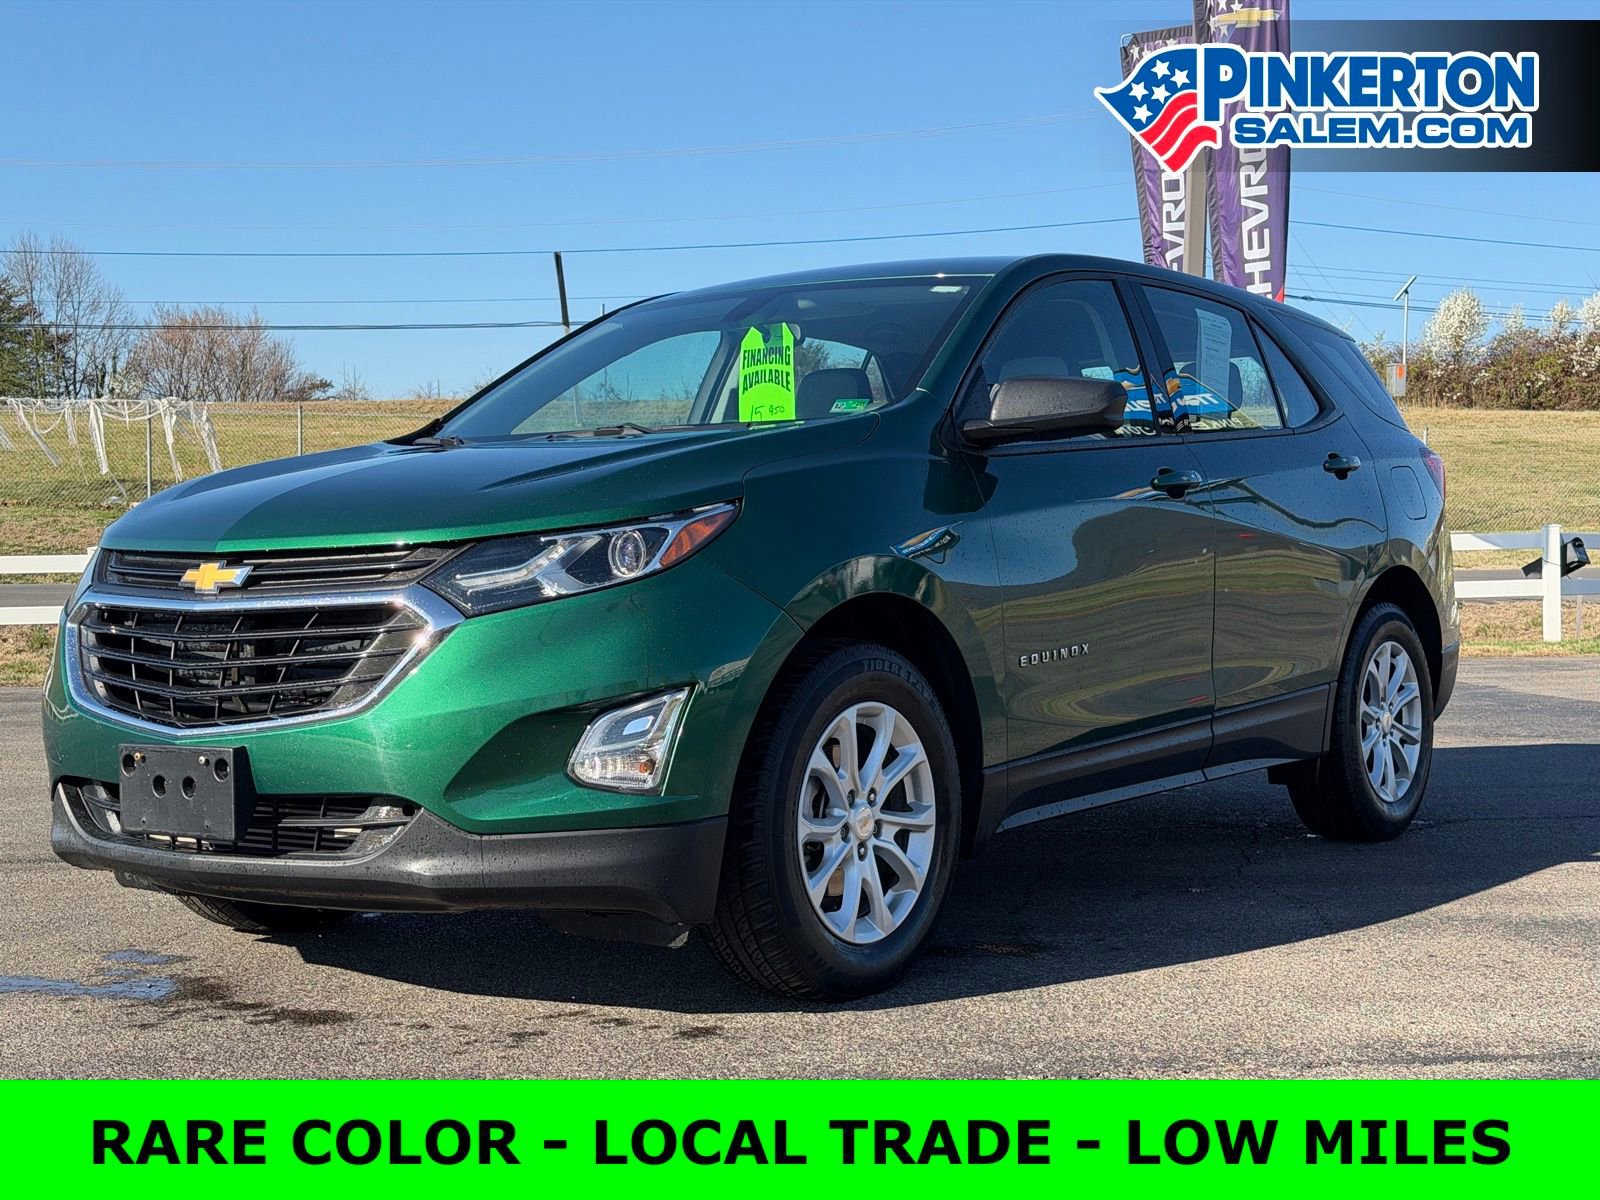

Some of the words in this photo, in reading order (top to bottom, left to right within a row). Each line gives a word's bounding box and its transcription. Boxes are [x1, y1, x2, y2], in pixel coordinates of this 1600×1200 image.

[1239, 147, 1273, 299] HEVRO
[742, 345, 791, 370] FINANCING
[742, 369, 791, 395] AVAILABLE
[862, 658, 899, 674] TIGER
[1019, 643, 1090, 668] EQUINOX
